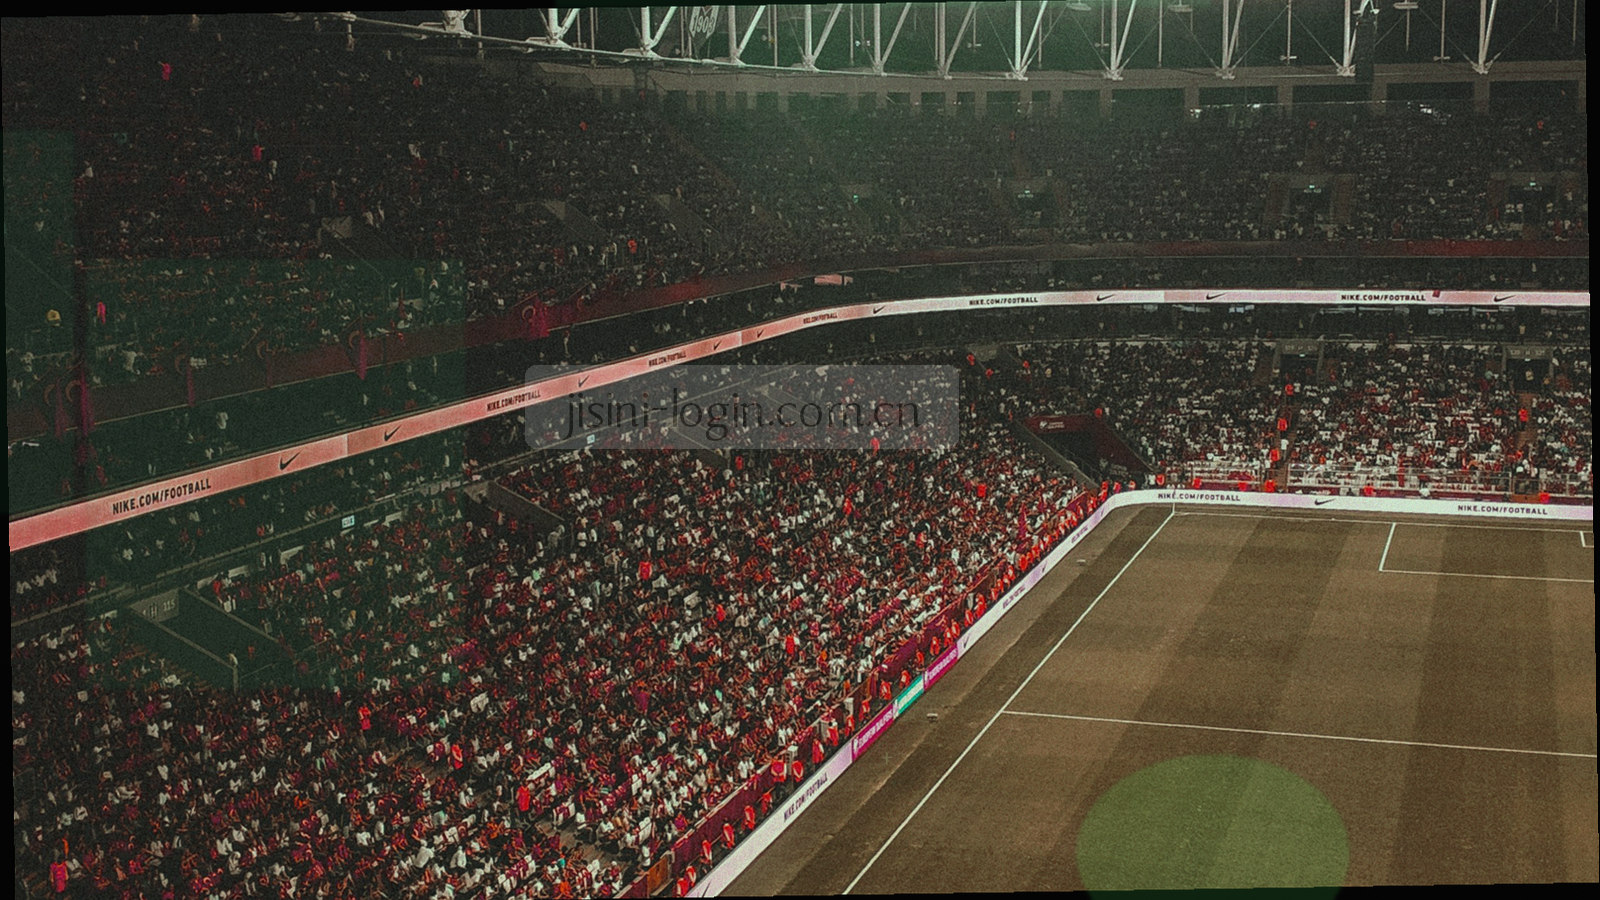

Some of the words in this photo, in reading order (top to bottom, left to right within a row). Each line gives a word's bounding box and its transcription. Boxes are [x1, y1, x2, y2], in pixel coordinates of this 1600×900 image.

[969, 297, 1038, 306] NIKE.COM/FOOTBALL
[1341, 294, 1426, 302] NIKE.COM/FOOTBALL
[112, 478, 212, 515] NIKE.COM/FOOTBALL
[1158, 491, 1240, 501] NIKE.COM/FOOTBALL
[1457, 505, 1548, 515] NIKE.COM/FOOTBALL
